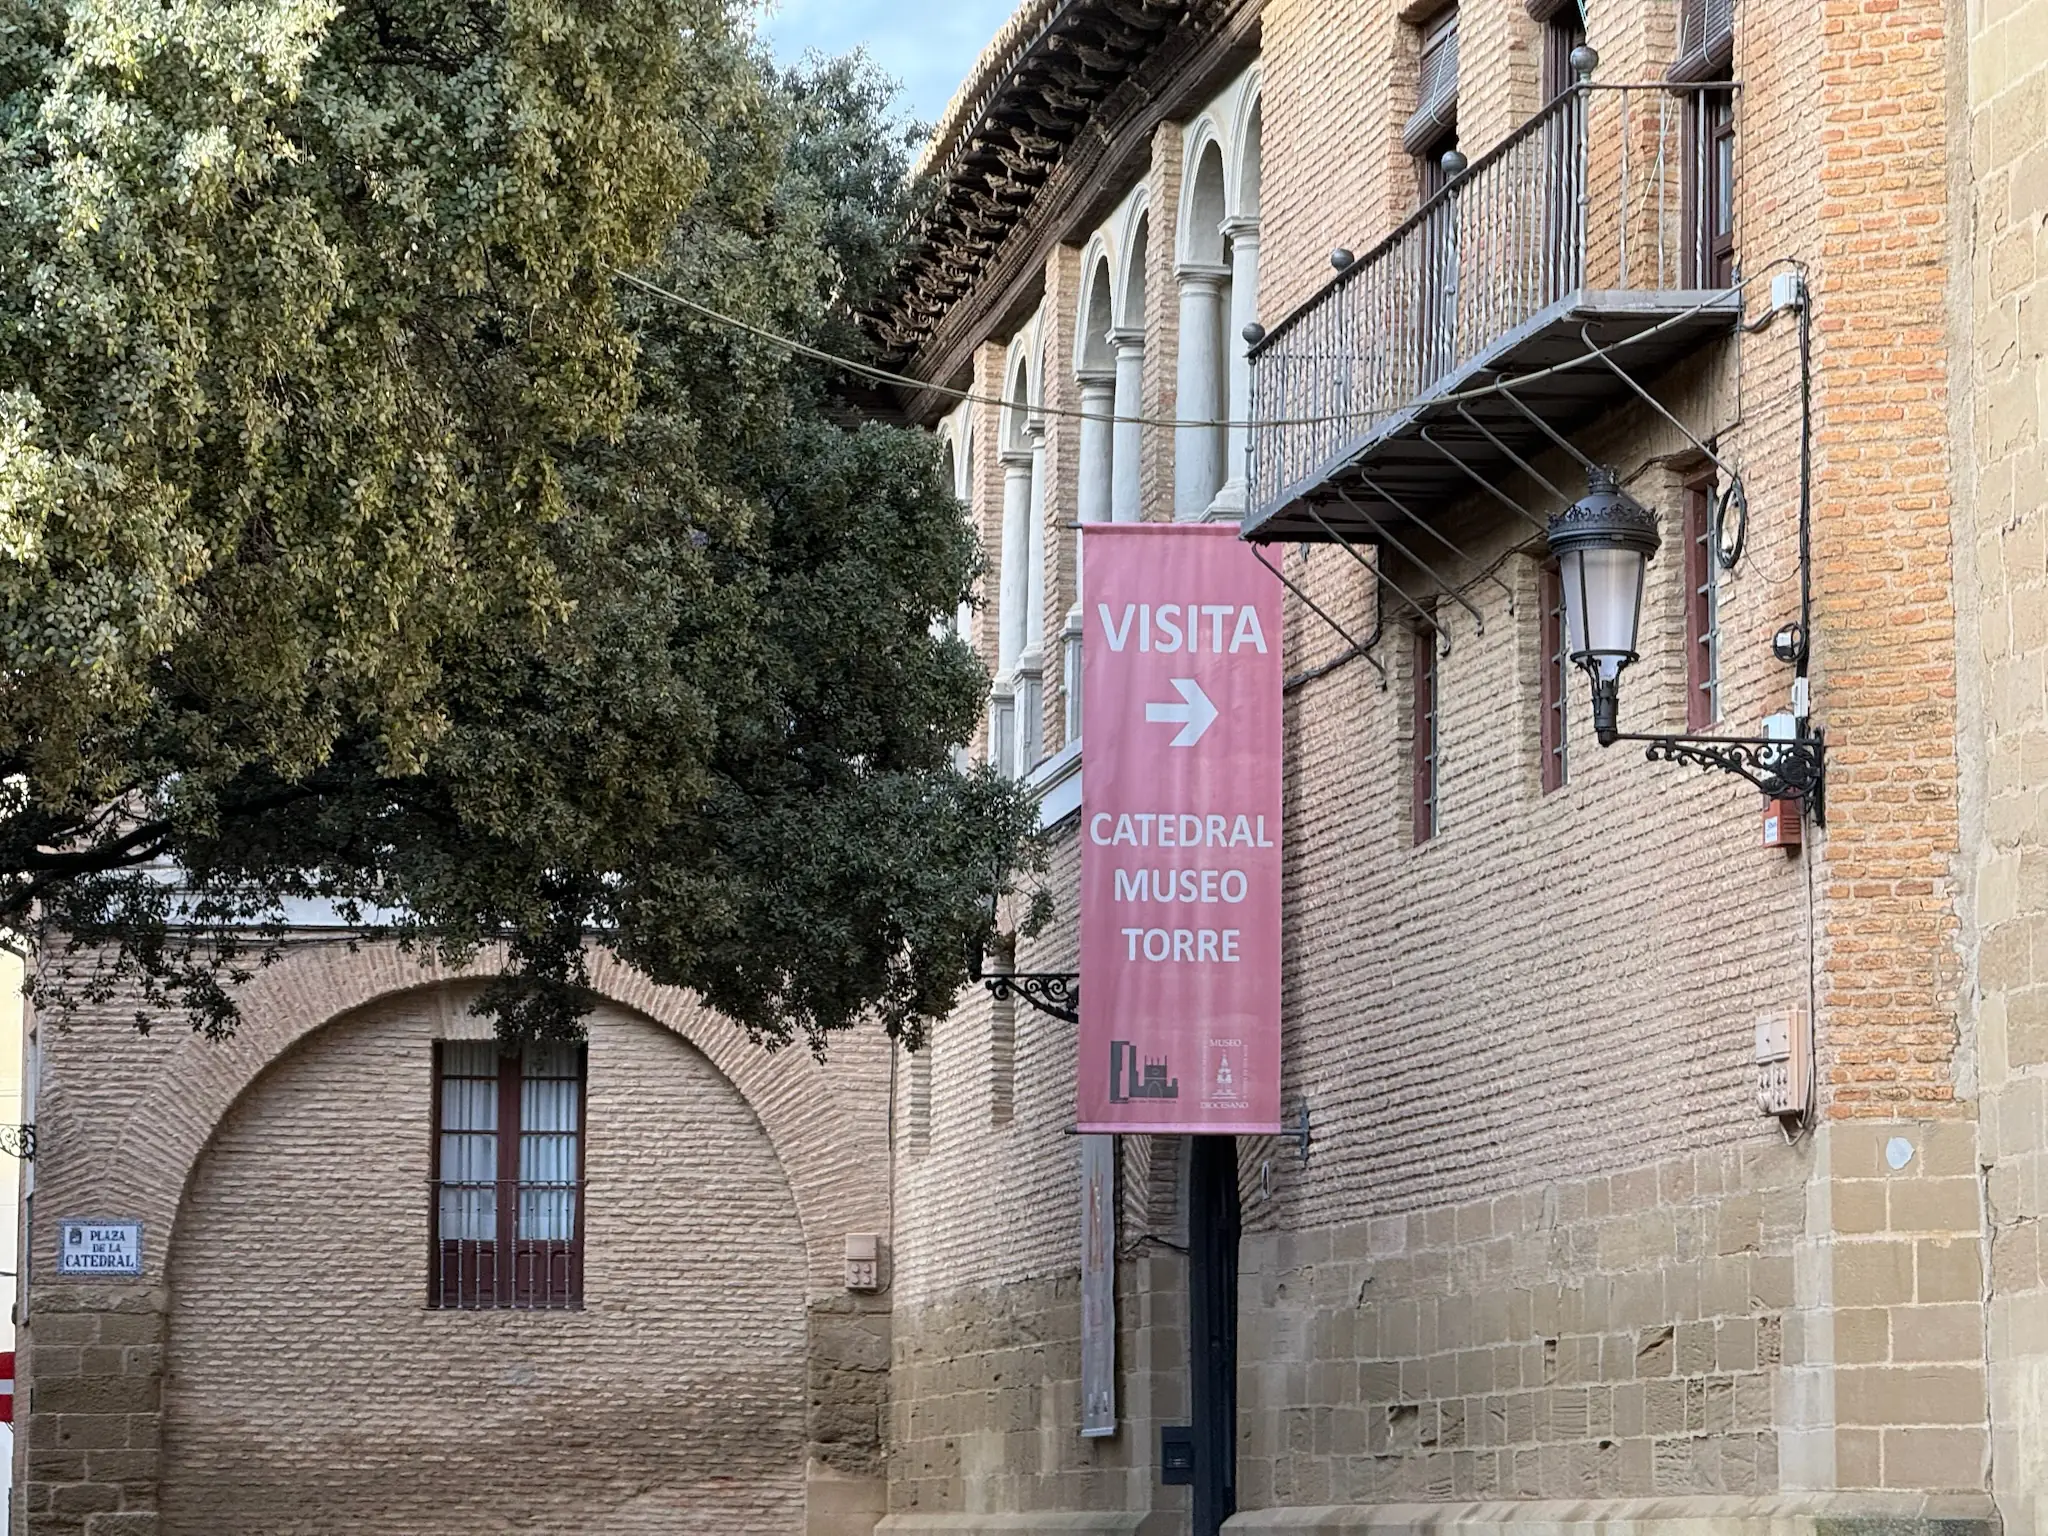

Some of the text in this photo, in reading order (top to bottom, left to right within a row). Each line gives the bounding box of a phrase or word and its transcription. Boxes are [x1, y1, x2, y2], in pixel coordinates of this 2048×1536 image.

[1098, 603, 1268, 654] VISITA
[1090, 813, 1273, 848] CATEDRAL
[1114, 868, 1248, 904] MUSEO
[1121, 928, 1241, 963] TORRE
[1209, 1039, 1242, 1047] MUSEO
[1200, 1101, 1249, 1109] DIOCESANO
[90, 1230, 126, 1241] PLAZA
[92, 1243, 122, 1253] DE LA
[65, 1254, 134, 1267] CATEDRAL
